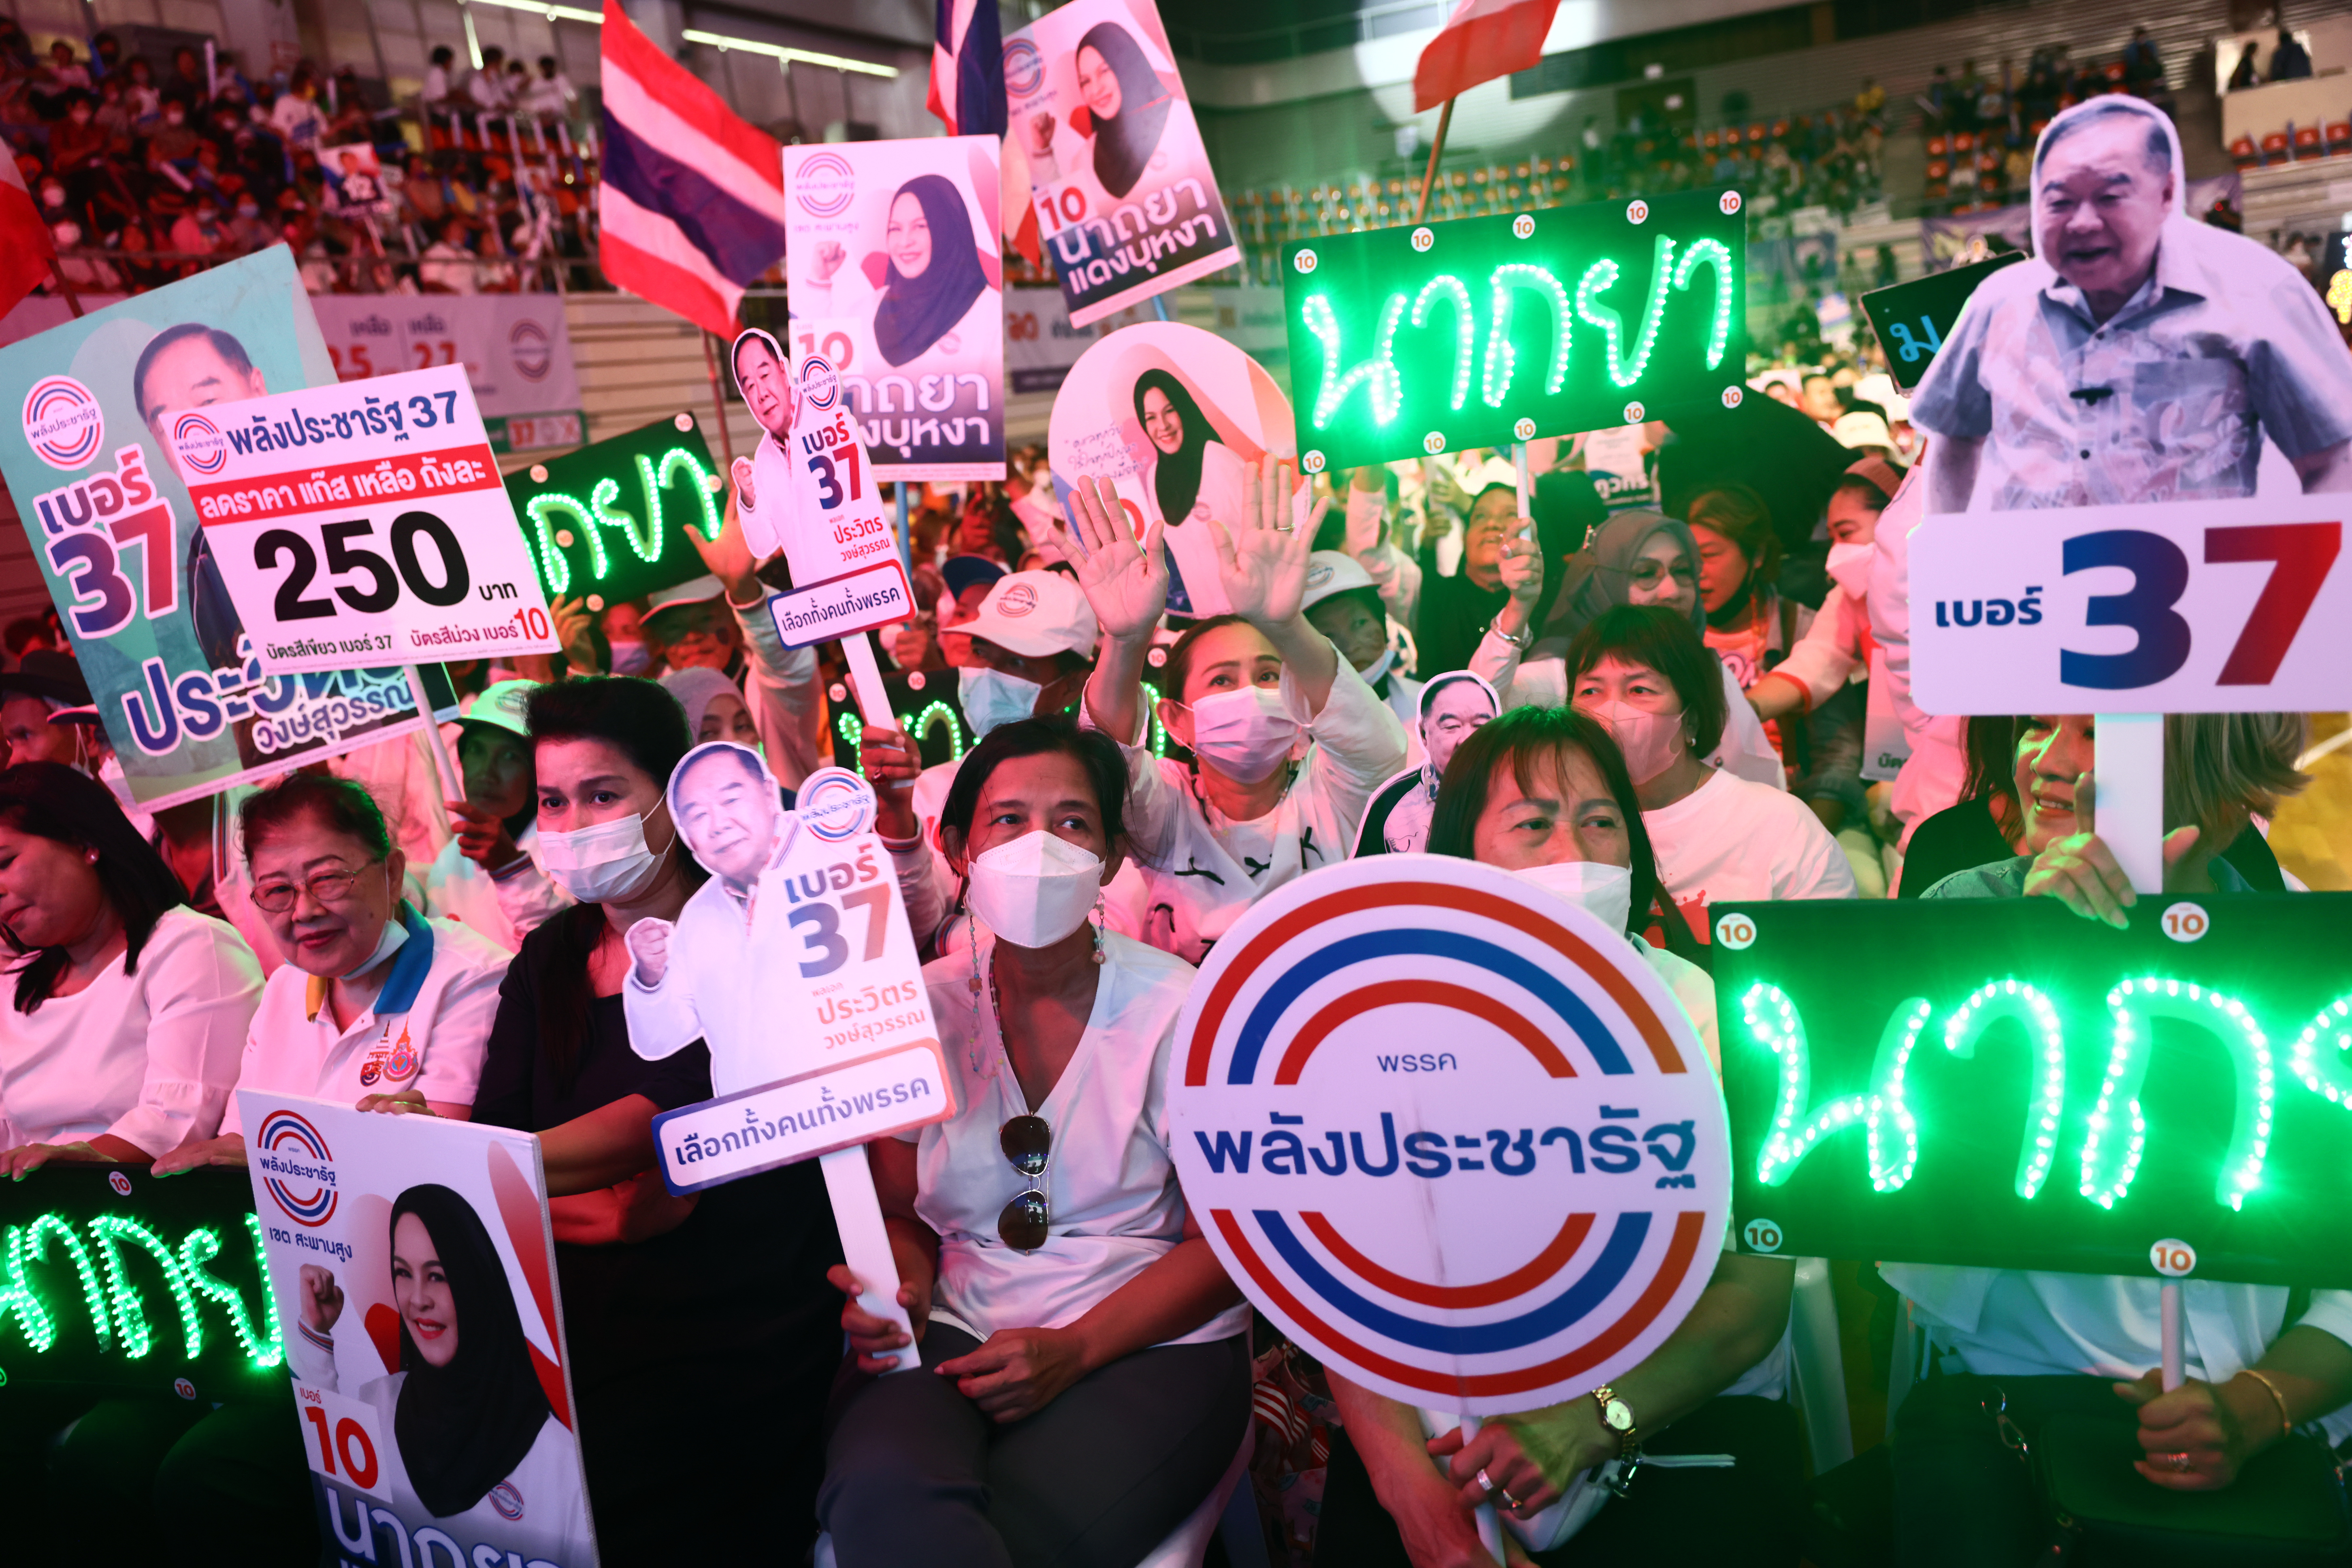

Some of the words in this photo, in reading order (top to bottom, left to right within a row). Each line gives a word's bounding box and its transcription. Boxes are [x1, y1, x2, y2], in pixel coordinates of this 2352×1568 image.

[1041, 186, 1087, 231] 10
[1055, 177, 1208, 264] นาถยา
[1629, 207, 1646, 219] 10
[1723, 197, 1738, 210] 10
[1414, 234, 1431, 247] 10
[1516, 222, 1533, 234] 10
[1067, 213, 1217, 295] แดงบุหงา
[1297, 256, 1314, 268] 10
[1301, 234, 1733, 431] นาถยา
[798, 331, 853, 372] 10
[1626, 407, 1643, 420] 10
[1724, 392, 1740, 404] 10
[226, 396, 409, 456] พลังประชารัฐ
[408, 390, 457, 428] 37
[802, 412, 850, 454] เบอร์
[1517, 424, 1534, 436] 10
[1426, 437, 1444, 450] 10
[807, 442, 861, 510] 37
[1305, 456, 1323, 469] 10
[38, 449, 152, 534] เบอร์
[200, 481, 297, 519] ลดราคา
[299, 471, 351, 505] แก๊ส
[354, 461, 416, 497] เหลือ
[420, 456, 487, 488] ถังละ
[834, 516, 884, 544] ประวิตร
[254, 510, 470, 622] 250
[841, 538, 890, 562] วงษ์สุวรรณ
[50, 504, 173, 633] 37
[479, 582, 518, 601] บาท
[1935, 586, 2043, 627] เบอร์
[2060, 521, 2342, 690] 37
[782, 587, 900, 632] เลือกทั้งคนทั้งพรรค
[411, 622, 480, 648] บัตรสีม่วง
[483, 617, 518, 640] เบอร์
[514, 607, 550, 641] 10
[266, 637, 337, 660] บัตรสีเขียว
[340, 633, 373, 654] เบอร์
[375, 635, 392, 650] 37
[783, 842, 879, 904] เบอร์
[787, 881, 891, 979] 37
[1720, 923, 1753, 943] 10
[2167, 914, 2204, 935] 10
[816, 979, 919, 1025] ประวิตร
[823, 1008, 926, 1050] วงษ์สุวรรณ
[1377, 1052, 1457, 1073] พรรค
[675, 1077, 931, 1166] เลือกทั้งคนทั้งพรรค
[1194, 1105, 1696, 1189] พลังประชารัฐ
[110, 1177, 130, 1192] 10
[260, 1155, 336, 1187] พลังประชารัฐ
[269, 1227, 291, 1244] เขต
[295, 1233, 353, 1263] สะพานสูง
[1748, 1227, 1779, 1247] 10
[2155, 1246, 2191, 1271] 10
[176, 1382, 195, 1398] 10
[300, 1387, 322, 1404] เบอร์
[304, 1406, 379, 1489] 10
